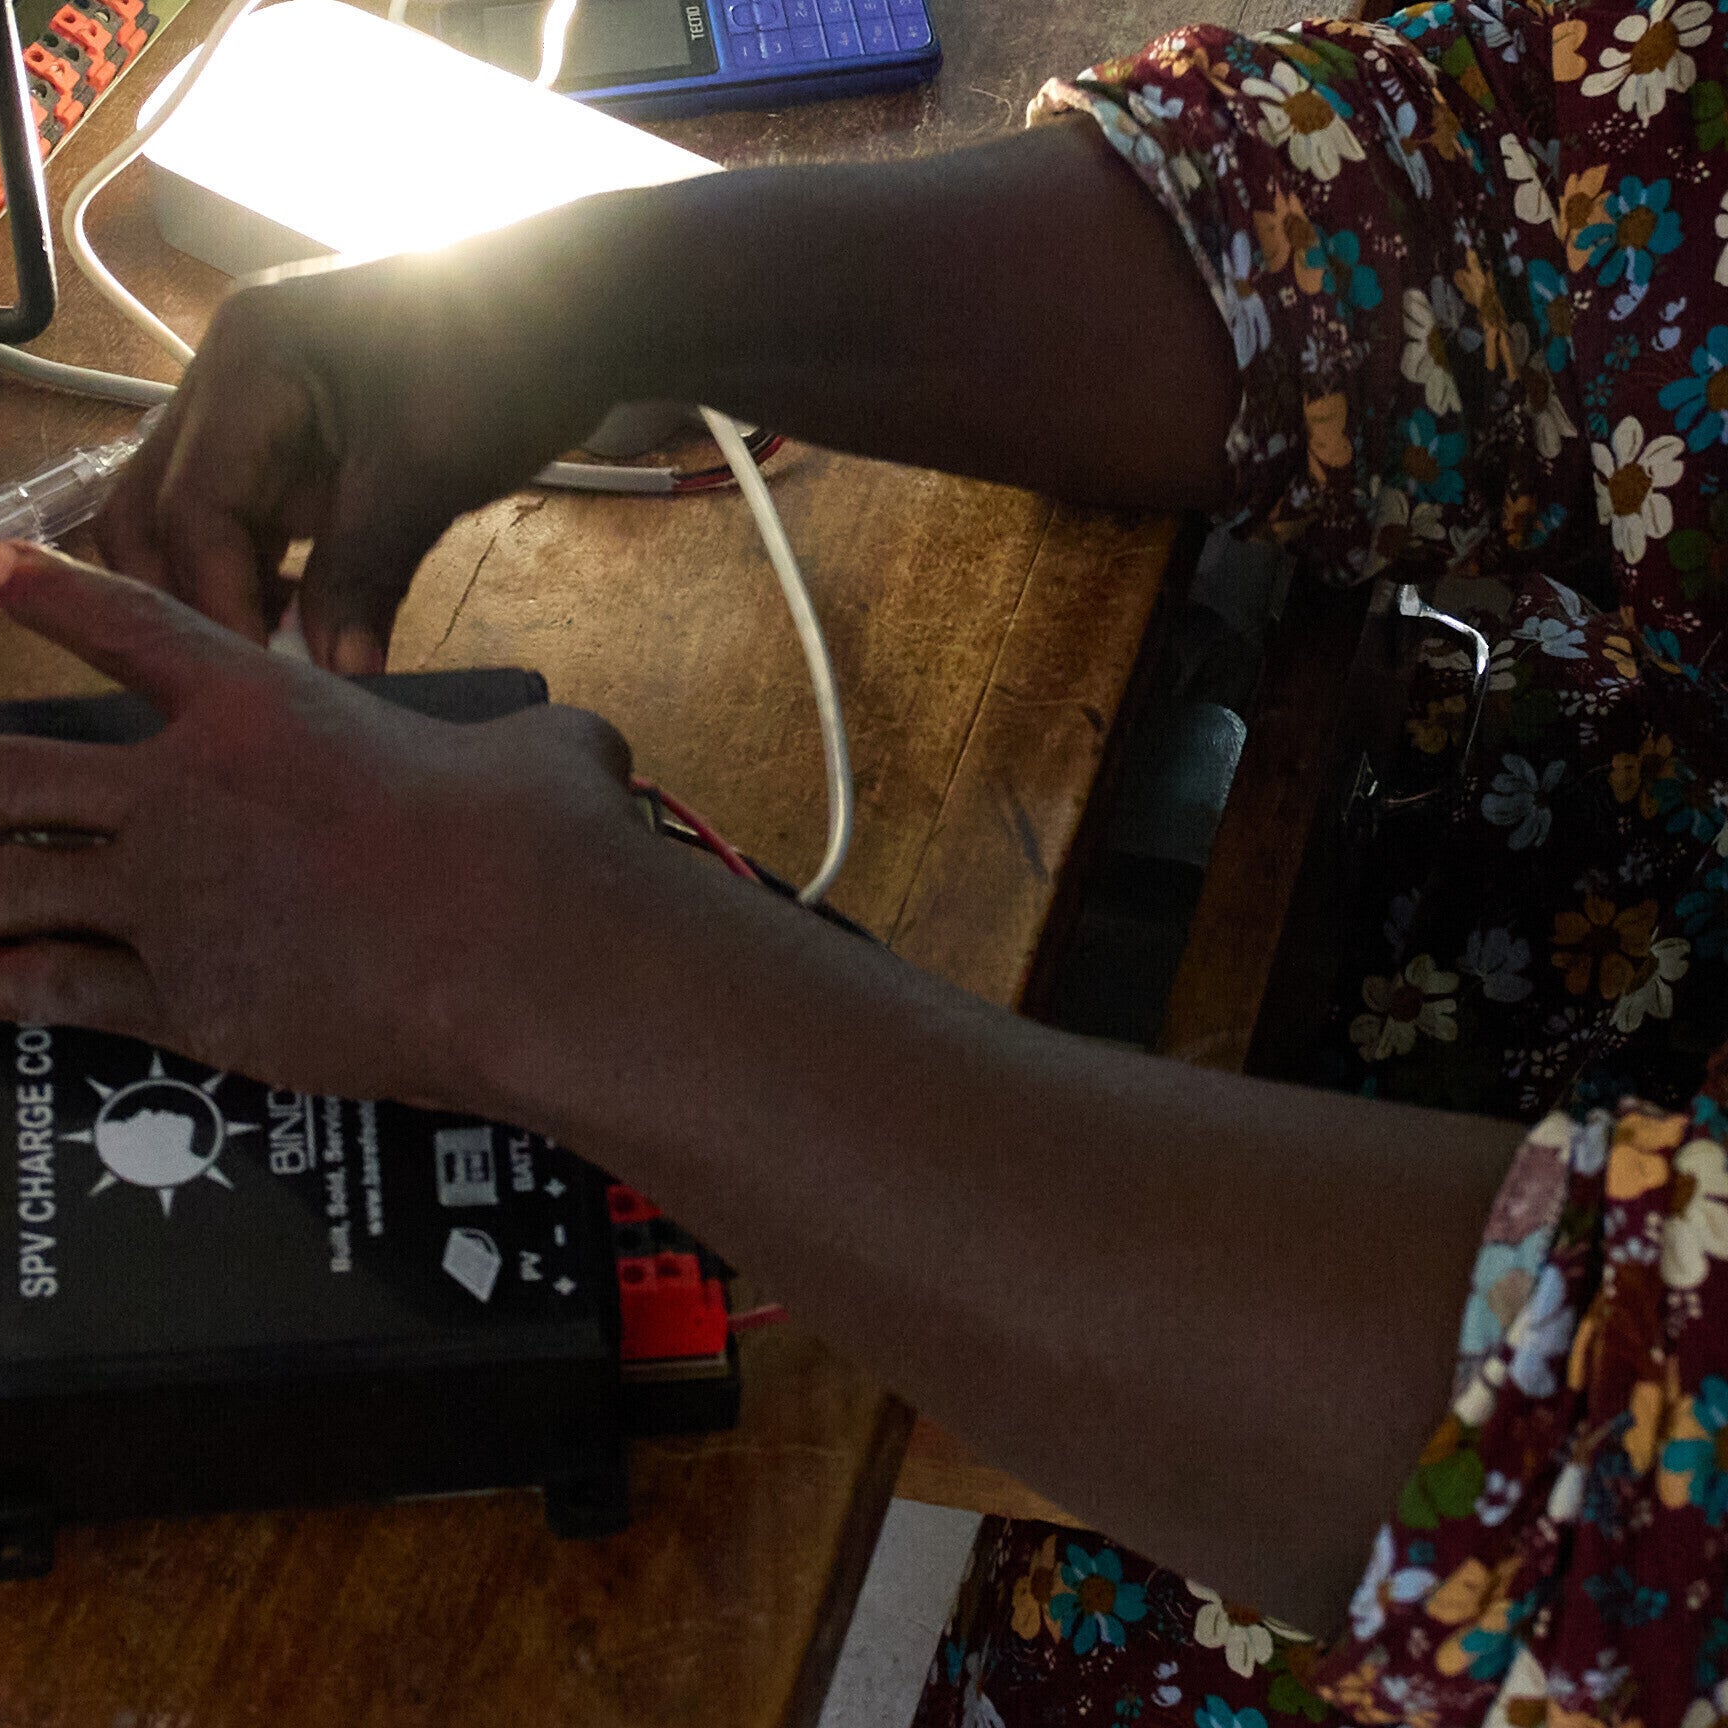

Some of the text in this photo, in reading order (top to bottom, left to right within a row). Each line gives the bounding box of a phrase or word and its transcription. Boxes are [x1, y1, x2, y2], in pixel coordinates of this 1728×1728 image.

[16, 1084, 56, 1223] CHARGE
[267, 1090, 308, 1175] BIND
[19, 1229, 58, 1299] SPV
[518, 1249, 544, 1282] PV
